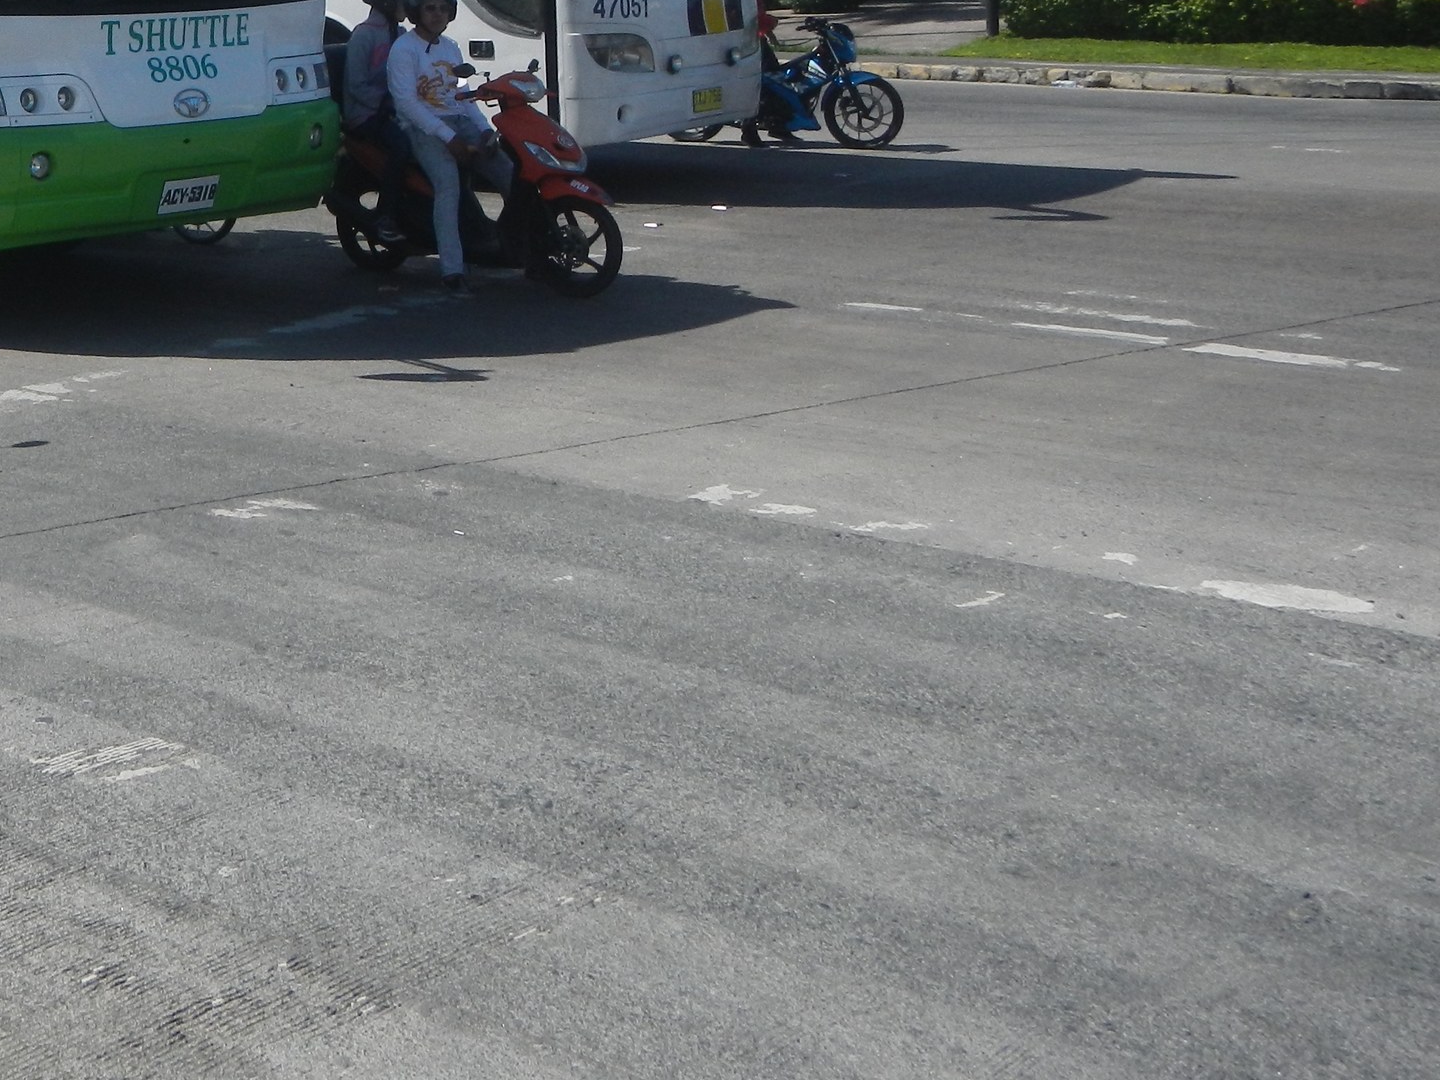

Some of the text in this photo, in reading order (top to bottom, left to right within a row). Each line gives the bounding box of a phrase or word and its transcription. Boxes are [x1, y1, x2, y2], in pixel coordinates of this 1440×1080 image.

[101, 13, 250, 56] T SHUTTLE
[147, 53, 218, 83] 8806
